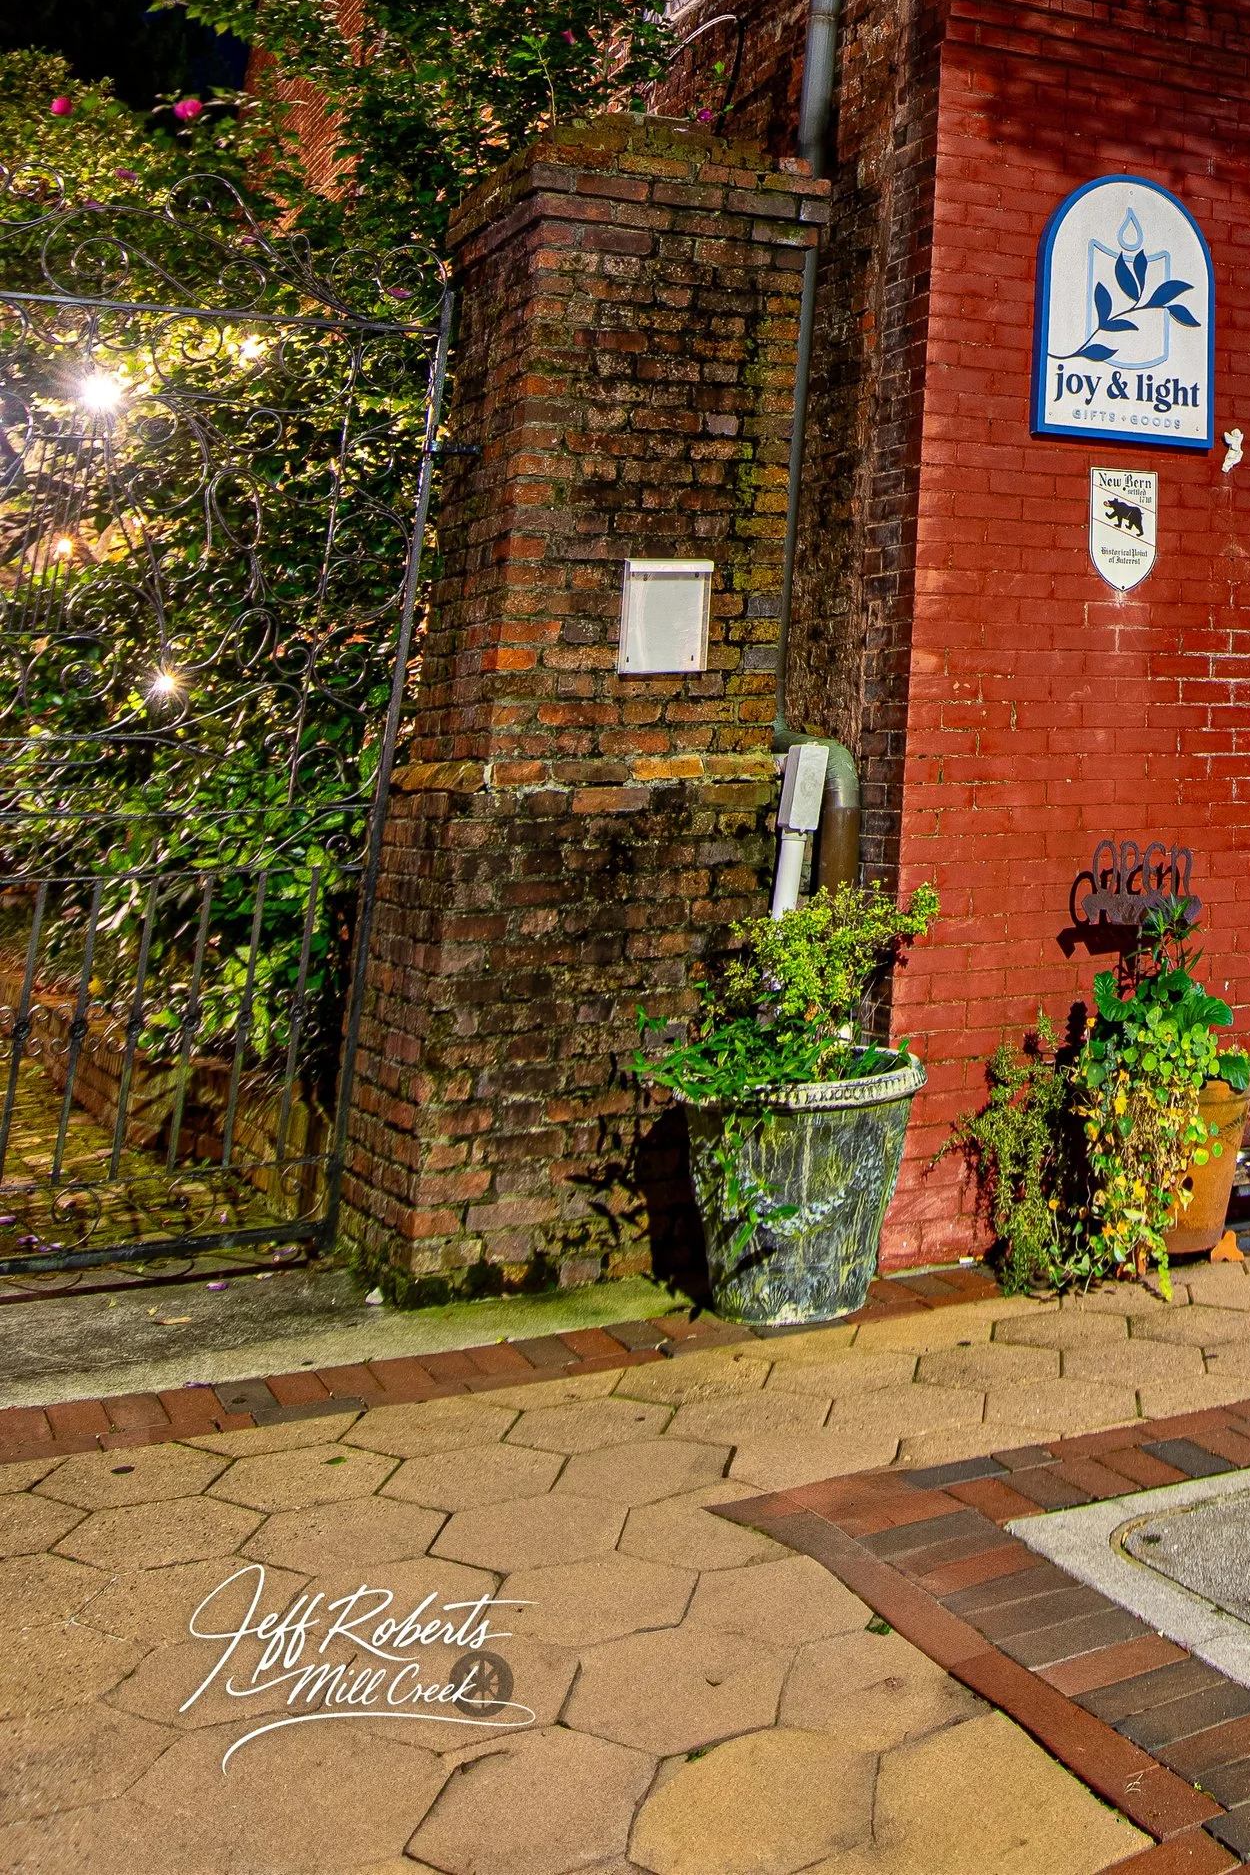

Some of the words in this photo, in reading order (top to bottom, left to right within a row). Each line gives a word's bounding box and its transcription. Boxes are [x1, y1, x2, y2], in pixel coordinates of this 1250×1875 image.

[1054, 364, 1102, 405] joy
[1106, 371, 1130, 399] &
[1136, 374, 1200, 413] light
[1072, 408, 1116, 422] GIFTS
[1130, 414, 1182, 429] GOODS
[1098, 472, 1122, 487] New
[1124, 473, 1152, 489] Bern
[1127, 488, 1147, 496] settled
[1101, 546, 1132, 557] Historical
[1132, 548, 1148, 558] Point
[1108, 556, 1115, 564] of
[1115, 555, 1141, 565] Interest
